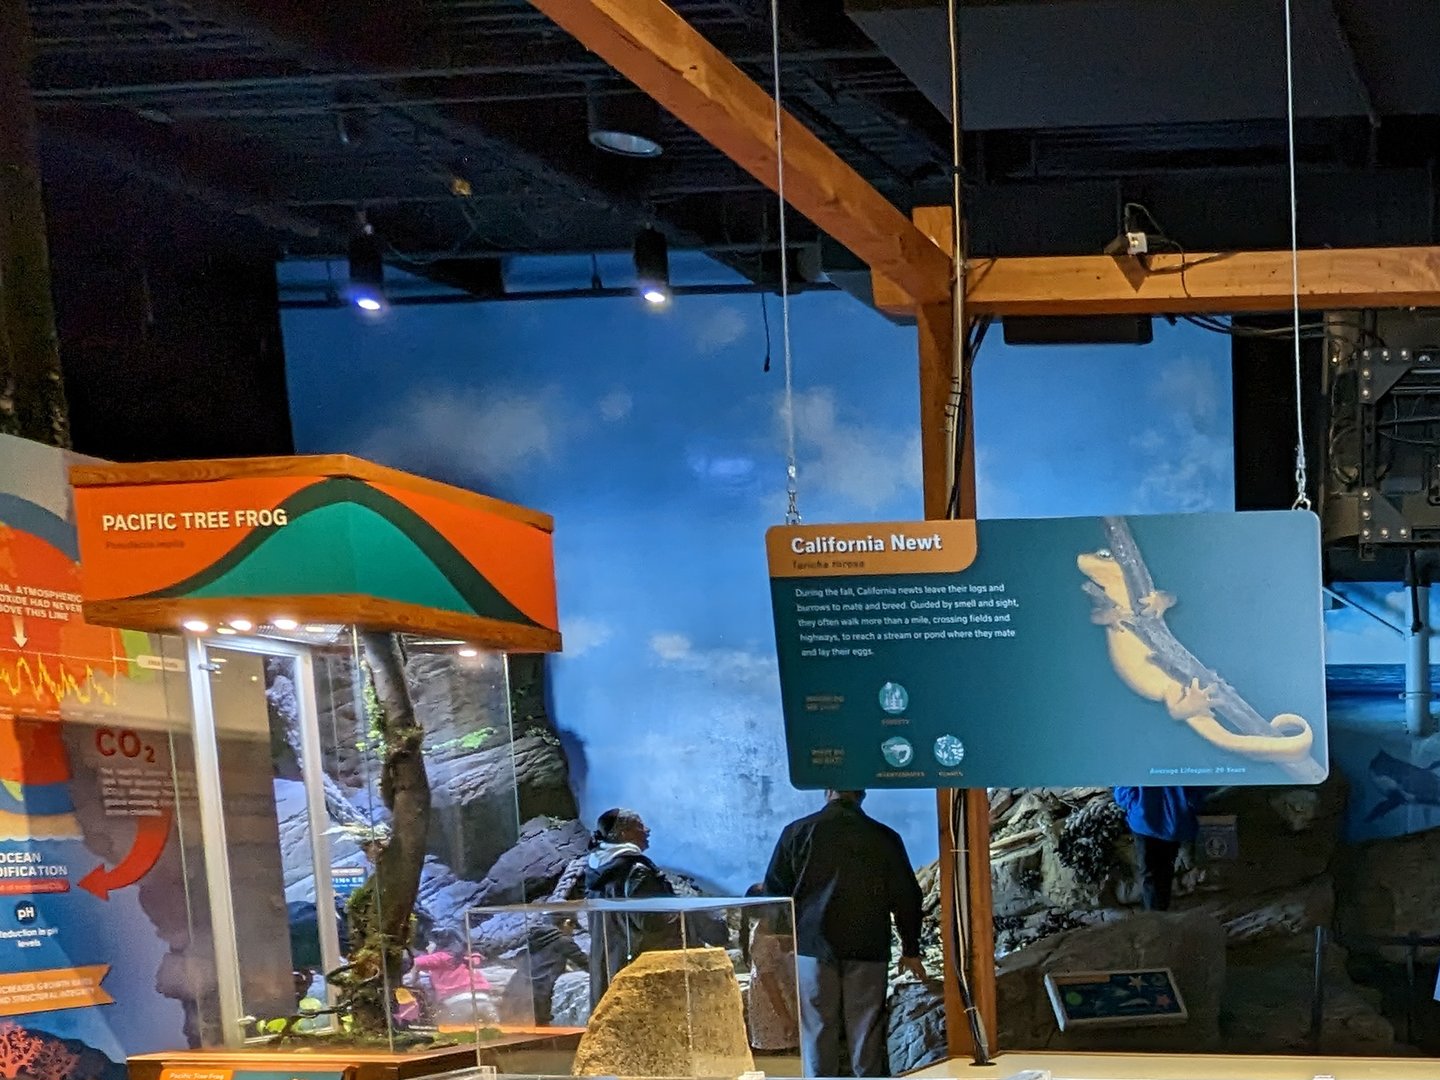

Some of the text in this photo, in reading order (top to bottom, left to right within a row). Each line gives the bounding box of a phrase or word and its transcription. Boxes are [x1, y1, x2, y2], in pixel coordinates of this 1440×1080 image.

[102, 508, 288, 531] PACIFIC TREE FROG
[791, 533, 943, 554] California Newt
[825, 588, 838, 596] the
[857, 586, 896, 596] California
[898, 586, 922, 594] newts
[924, 586, 946, 594] leave
[948, 584, 967, 592] their
[969, 584, 987, 594] logs
[989, 584, 1004, 592] and
[30, 598, 50, 608] HAD
[52, 601, 82, 613] NEVER
[842, 603, 862, 611] mate
[864, 602, 880, 610] and
[910, 600, 940, 609] Guided
[942, 600, 952, 610] by
[954, 599, 976, 608] smell
[978, 599, 994, 607] and
[25, 606, 47, 618] THIS
[798, 618, 816, 628] they
[817, 618, 839, 626] often
[841, 617, 859, 625] walk
[932, 615, 968, 624] crossing
[970, 614, 993, 622] fields
[994, 614, 1010, 622] and
[842, 633, 850, 641] to
[852, 632, 875, 640] reach
[884, 632, 912, 640] stream
[924, 630, 946, 640] pond
[947, 630, 973, 638] where
[974, 629, 993, 638] they
[994, 629, 1016, 637] mate
[801, 648, 817, 656] and
[818, 648, 830, 657] lay
[17, 906, 35, 920] pH
